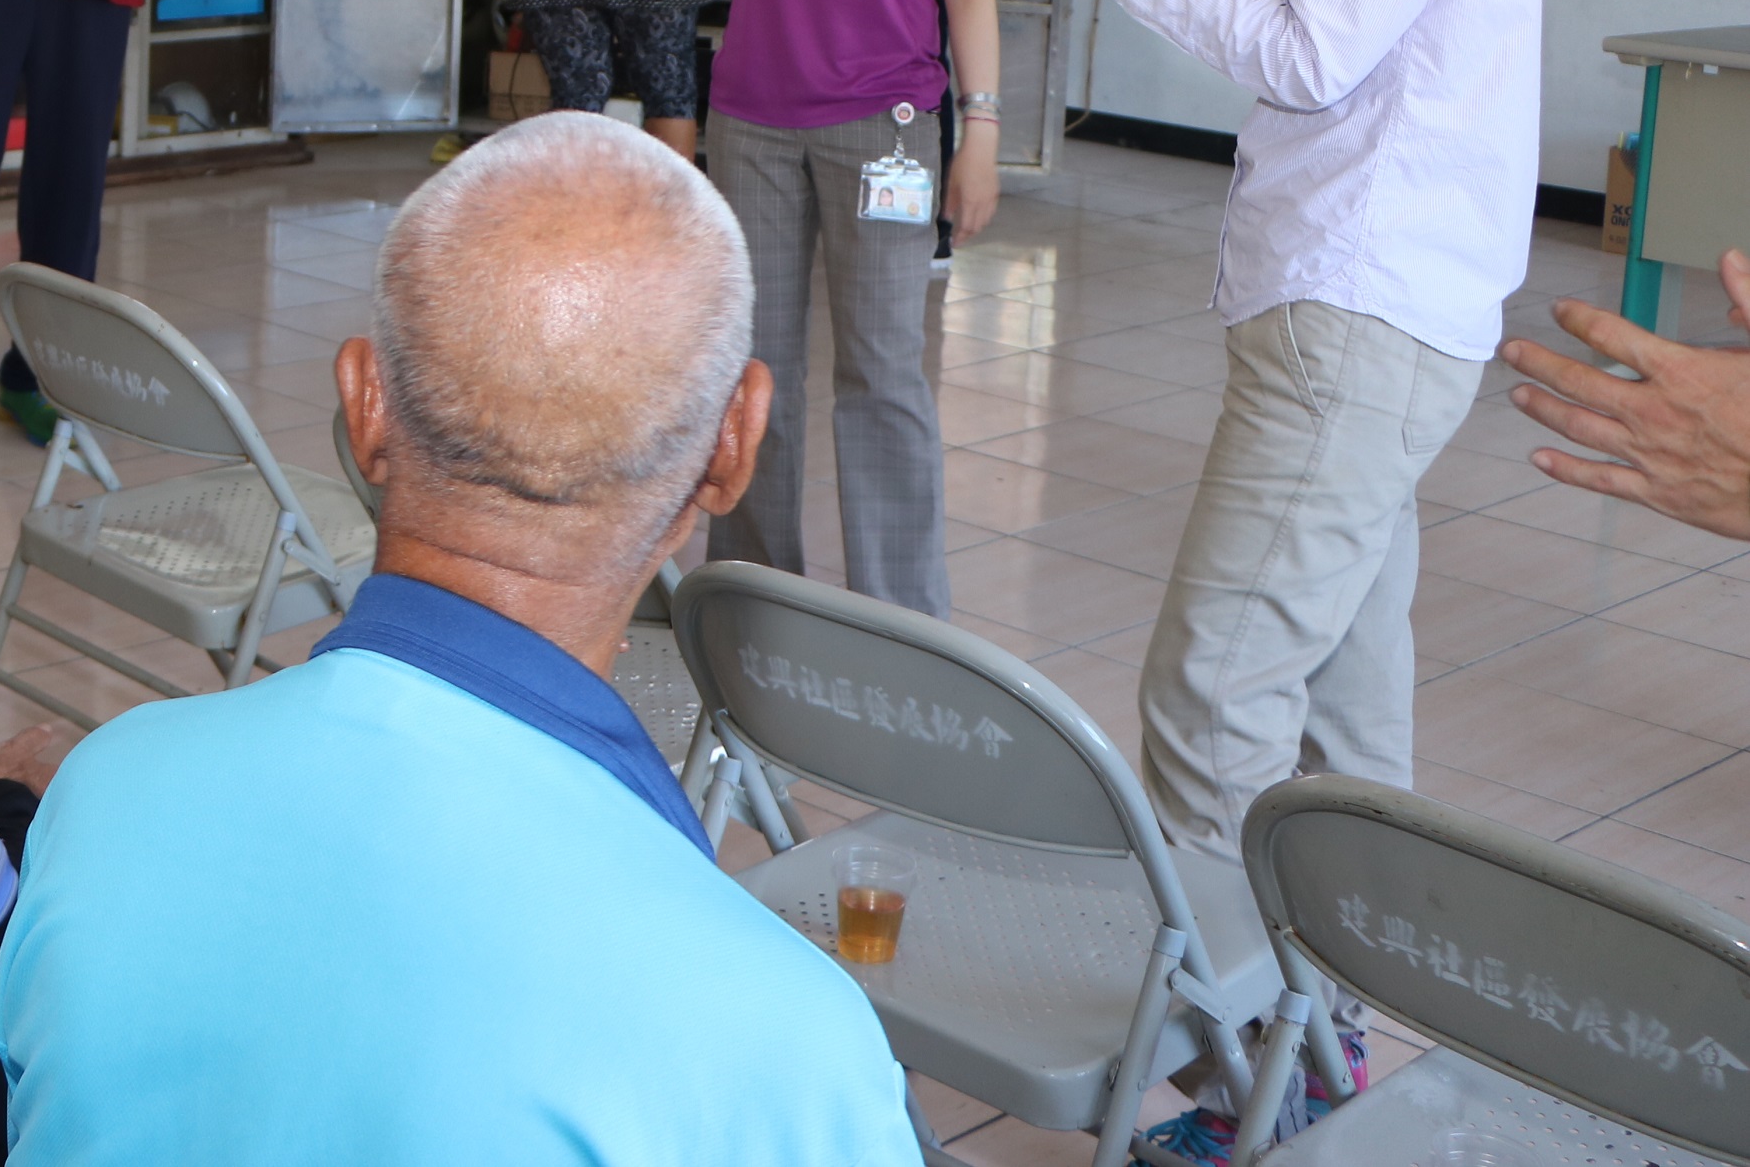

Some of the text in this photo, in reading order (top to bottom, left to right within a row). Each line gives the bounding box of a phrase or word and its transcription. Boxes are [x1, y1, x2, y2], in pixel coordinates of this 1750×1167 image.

[1336, 893, 1749, 1092] 建興社區發展協會
